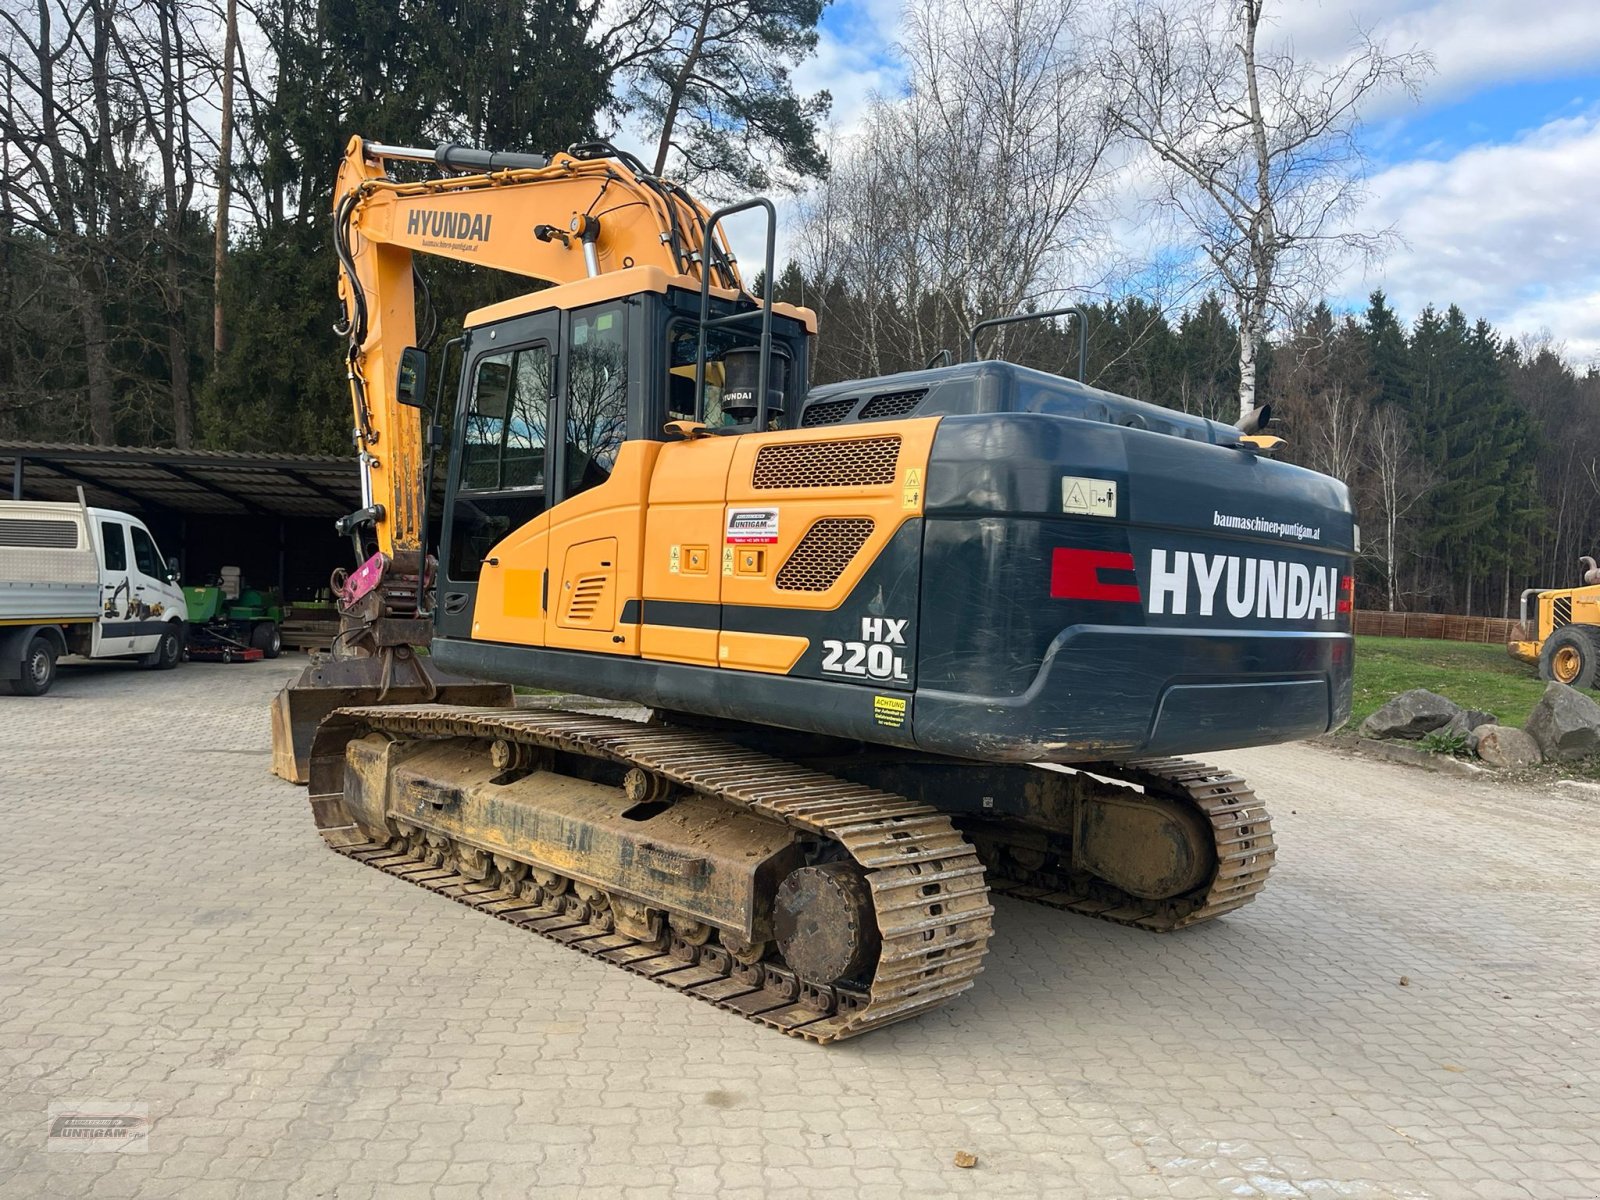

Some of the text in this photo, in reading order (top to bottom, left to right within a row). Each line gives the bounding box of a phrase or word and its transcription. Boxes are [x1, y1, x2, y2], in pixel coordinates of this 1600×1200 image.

[407, 209, 492, 241] HYUNDAI
[1213, 510, 1320, 540] baumaschinen-puntigam.at
[1148, 549, 1338, 620] HYUNDAI
[862, 617, 908, 644] HX
[822, 640, 908, 679] 220L
[876, 699, 904, 708] ACHTUNG
